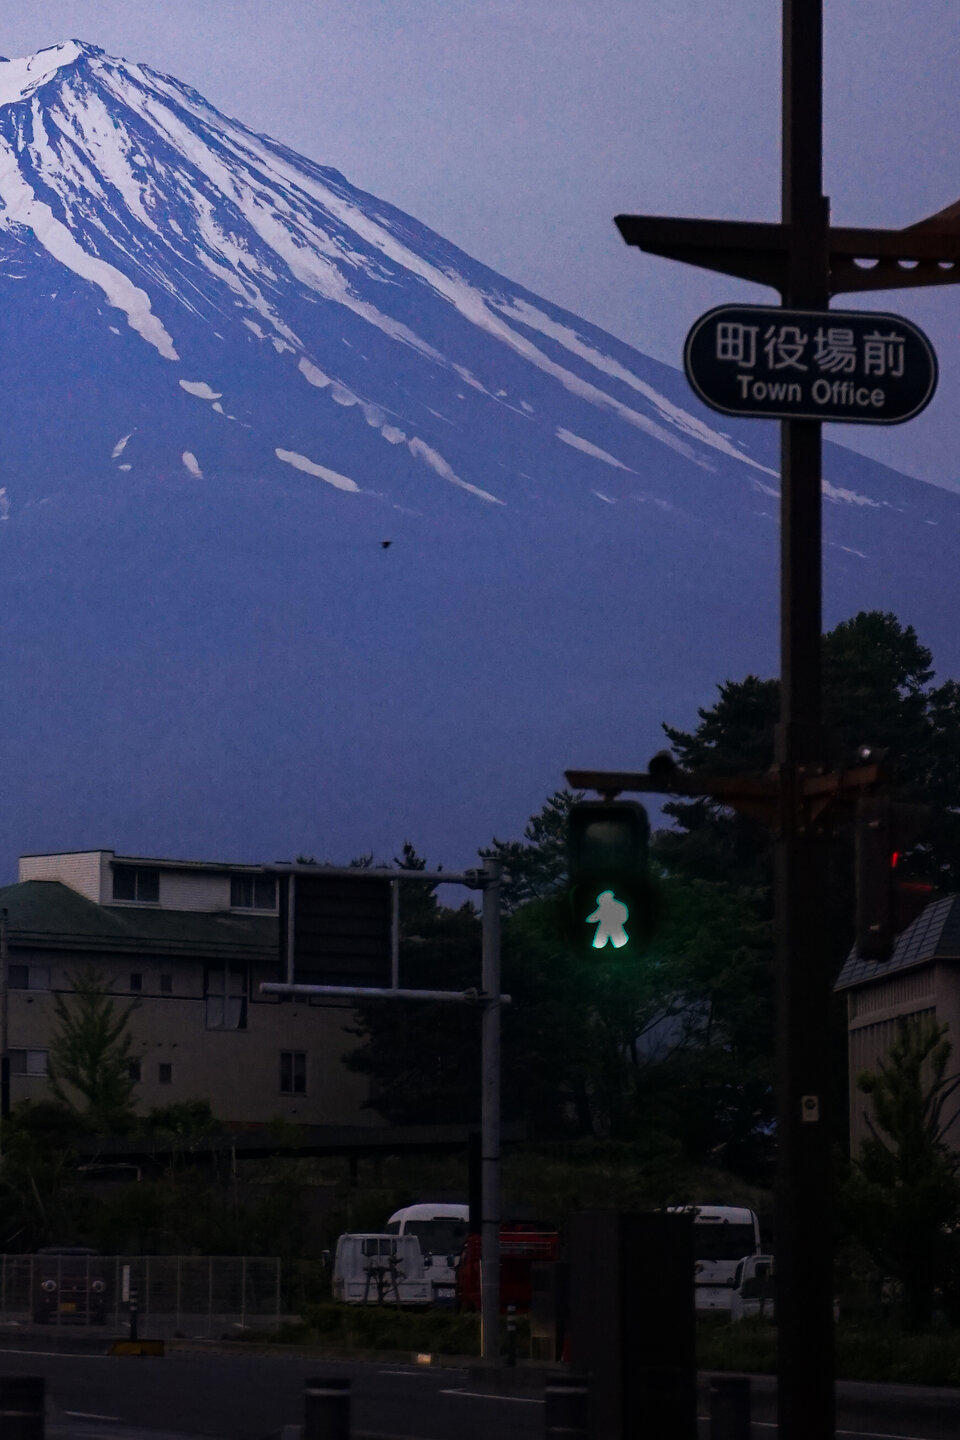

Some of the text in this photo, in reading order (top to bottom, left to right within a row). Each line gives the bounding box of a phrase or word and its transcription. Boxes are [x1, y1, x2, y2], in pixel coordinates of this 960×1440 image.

[716, 322, 907, 377] 町役場前
[737, 375, 886, 407] Town Office
